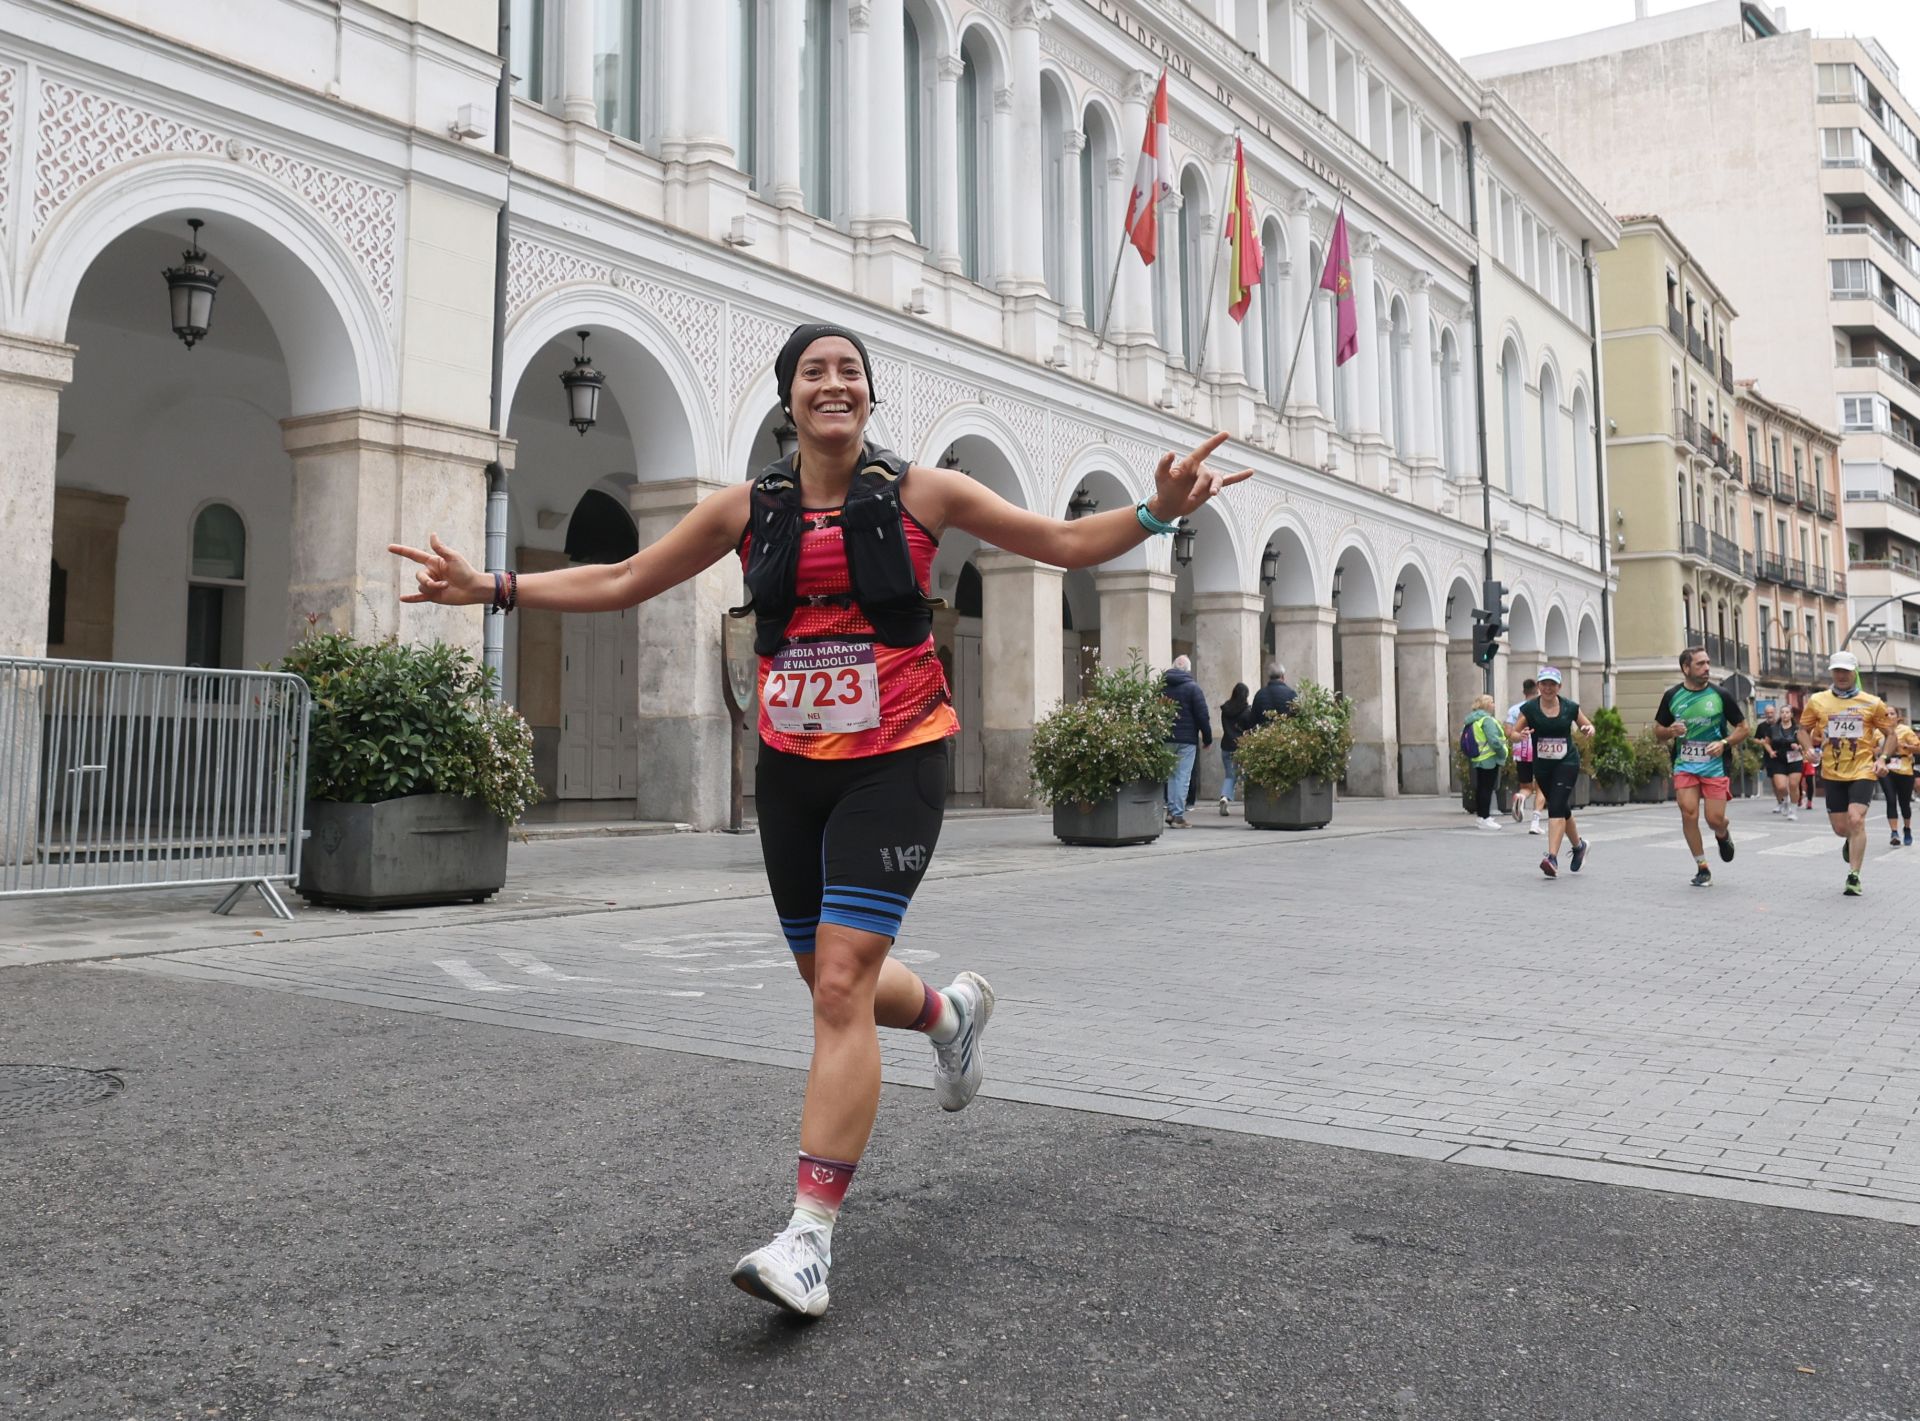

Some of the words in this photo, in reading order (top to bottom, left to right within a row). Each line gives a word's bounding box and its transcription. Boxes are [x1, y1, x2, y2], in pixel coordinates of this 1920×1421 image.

[1216, 85, 1234, 108] DE
[788, 648, 814, 659] MEDIA
[783, 659, 791, 669] DE
[792, 655, 857, 669] VALLADOLID
[768, 668, 863, 708] 2723
[1833, 721, 1856, 731] 746
[1538, 743, 1563, 753] 2210
[1682, 745, 1706, 757] 2211
